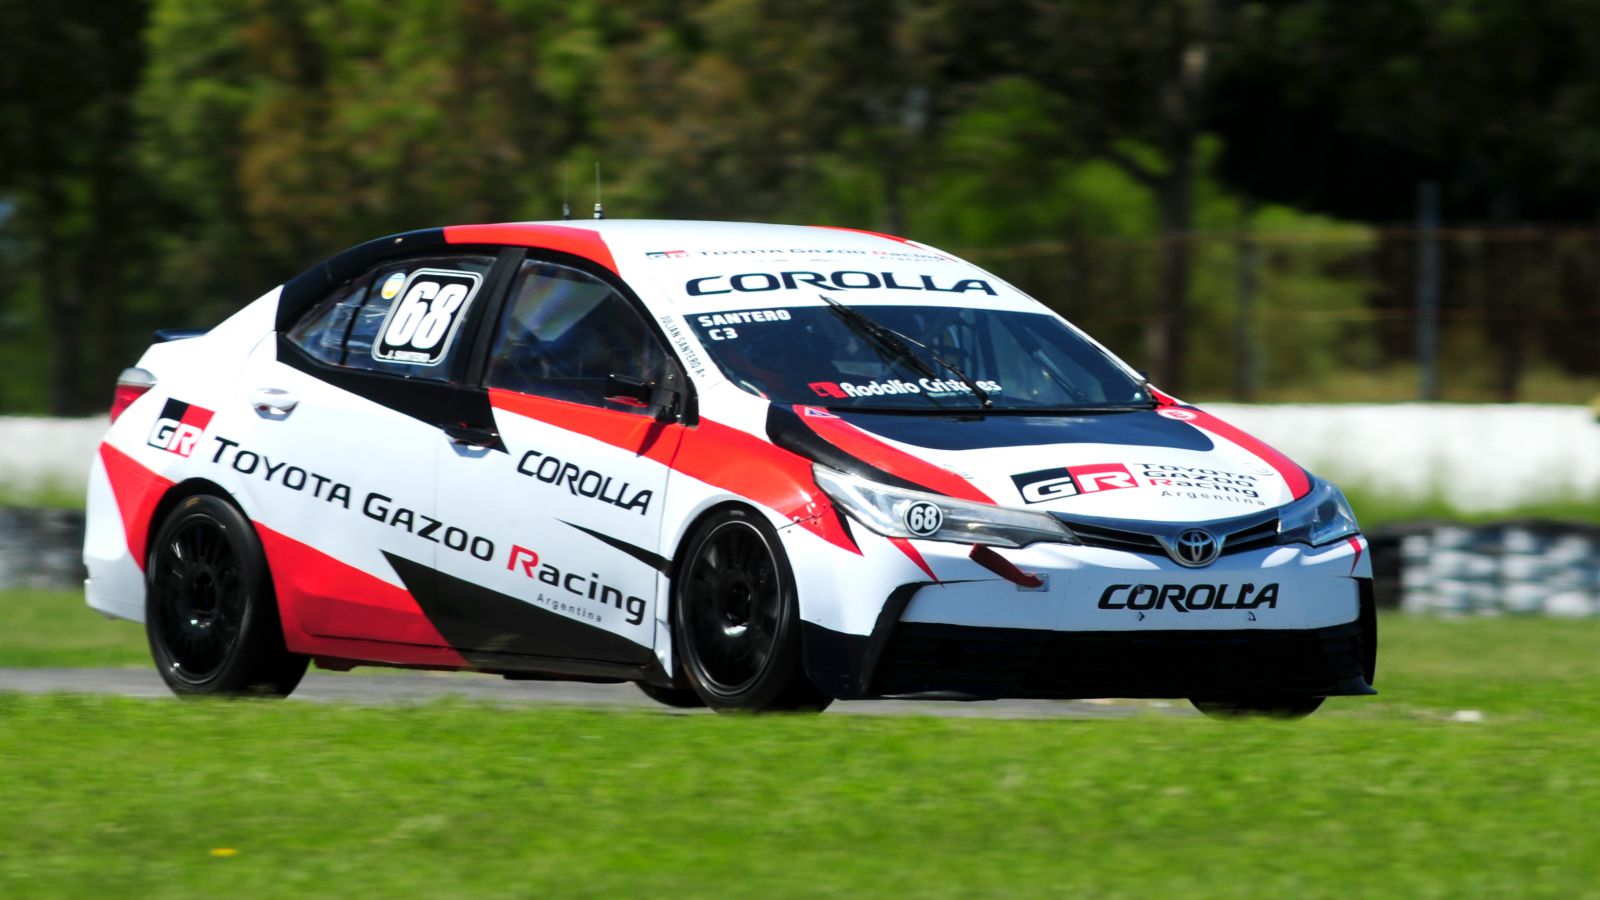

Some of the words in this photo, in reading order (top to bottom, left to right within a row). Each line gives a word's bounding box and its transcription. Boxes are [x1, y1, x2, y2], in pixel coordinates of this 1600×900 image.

[685, 270, 999, 297] COROLLA
[384, 281, 469, 349] 68
[697, 309, 792, 327] SANTERO
[660, 315, 678, 338] JULIAN
[674, 337, 701, 371] SANTERO
[708, 327, 738, 341] C3
[839, 379, 920, 398] Rodolfo
[918, 378, 1002, 393] Cristes
[147, 417, 204, 458] GR
[516, 449, 654, 516] COROLLA
[1134, 462, 1259, 481] TOYOTA
[1142, 470, 1254, 488] GAZOO
[1021, 471, 1138, 504] GR
[1148, 478, 1260, 498] Racing
[1161, 490, 1267, 507] Argentina
[211, 436, 351, 510] TOYOTA
[362, 491, 495, 562] GAZOO
[506, 544, 647, 626] Racing
[910, 505, 938, 531] 68
[536, 592, 603, 623] Argentina
[1097, 582, 1280, 613] COROLLA
